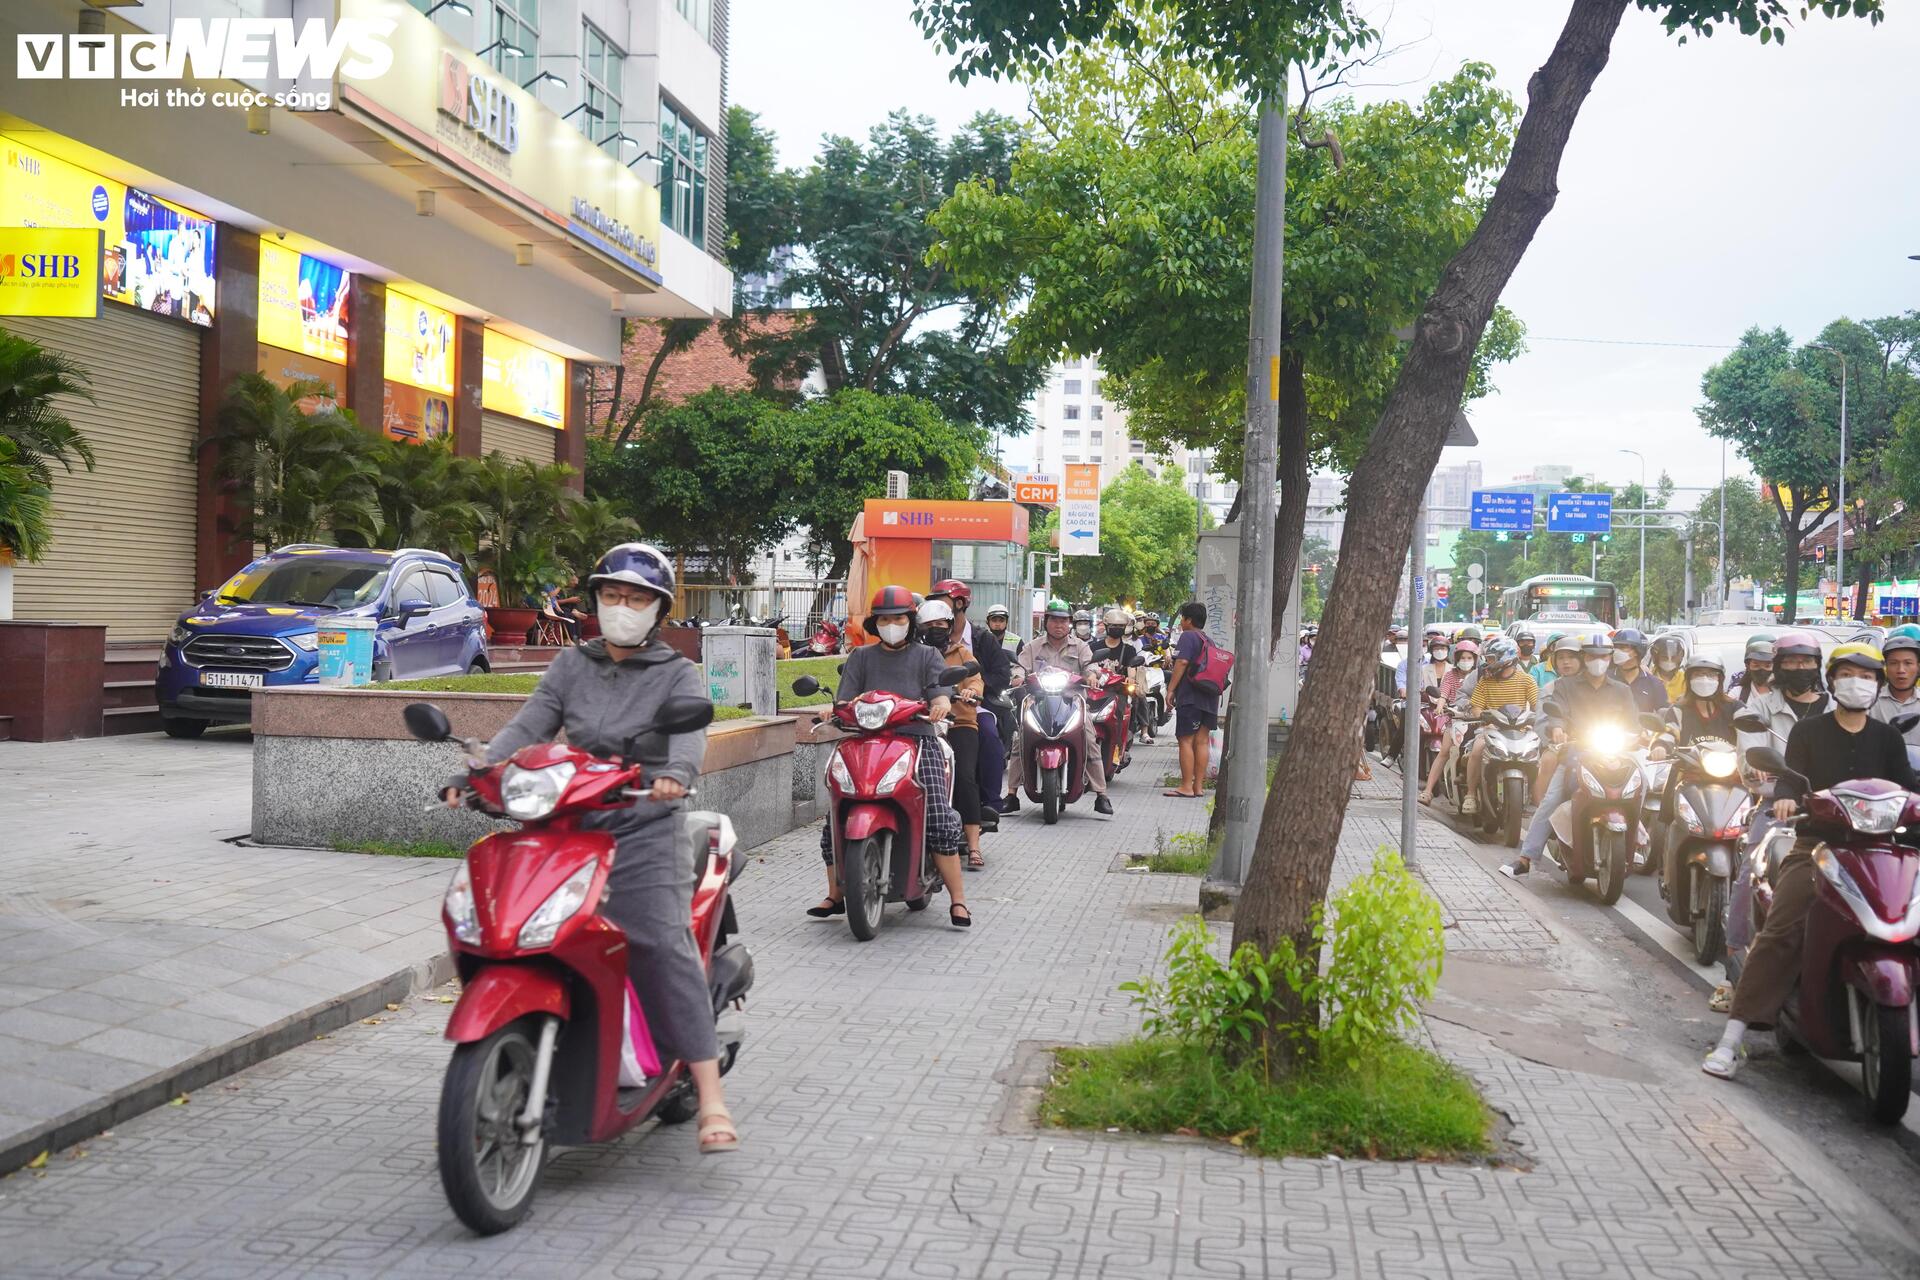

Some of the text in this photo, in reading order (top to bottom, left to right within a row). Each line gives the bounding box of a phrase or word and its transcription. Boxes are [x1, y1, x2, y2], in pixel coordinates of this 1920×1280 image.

[469, 74, 519, 155] SHB
[21, 254, 80, 278] SHB
[1020, 487, 1054, 500] CRM
[900, 512, 934, 526] SHB
[1572, 533, 1585, 542] 60
[208, 673, 260, 687] 51H-114.71
